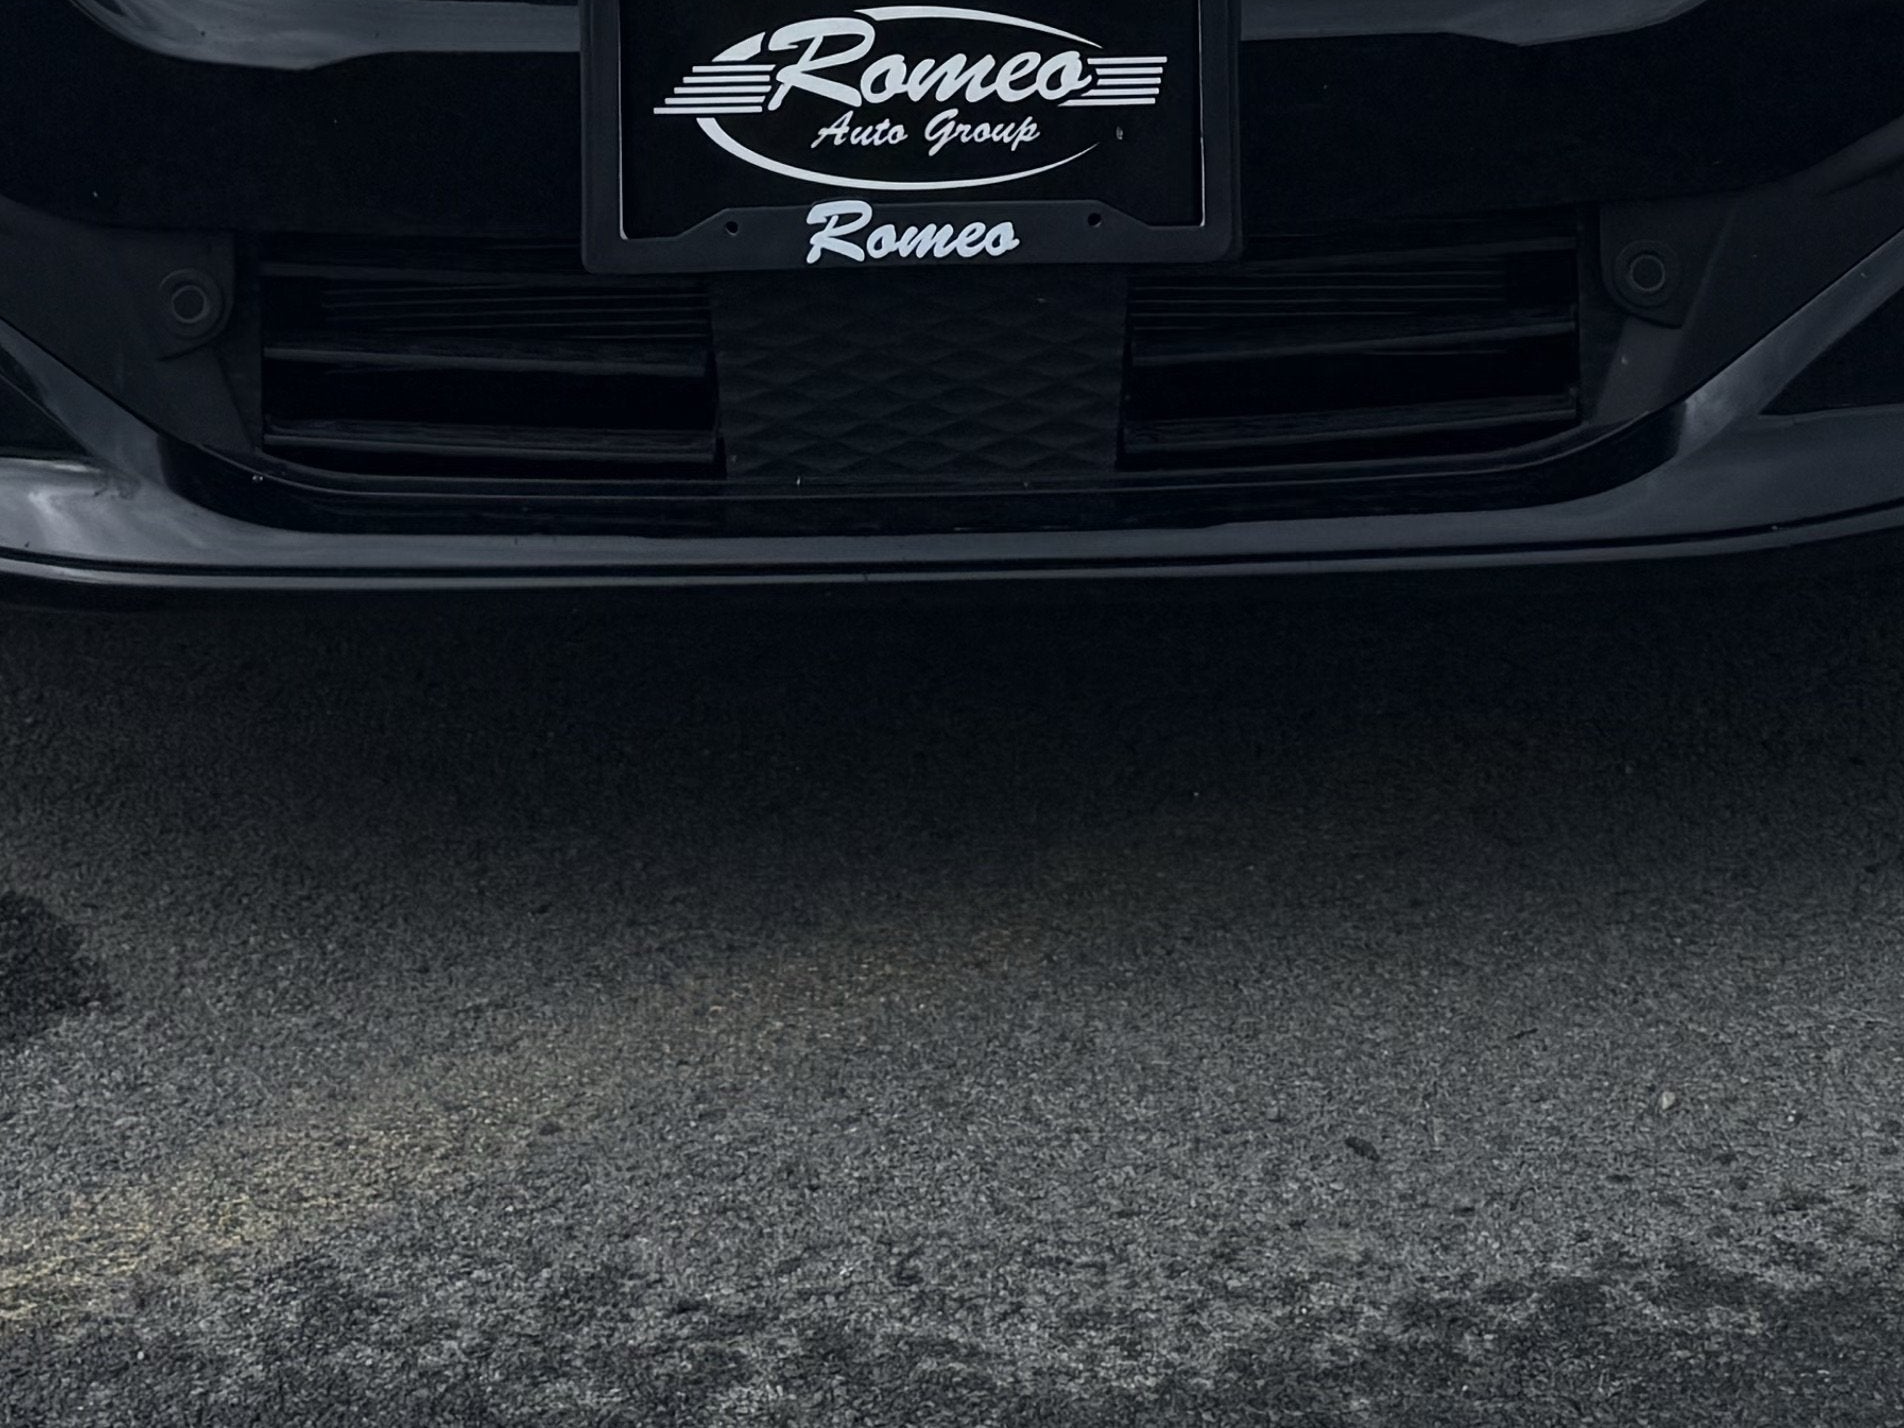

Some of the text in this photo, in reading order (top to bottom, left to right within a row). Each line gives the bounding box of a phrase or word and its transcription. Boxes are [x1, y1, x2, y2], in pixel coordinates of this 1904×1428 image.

[767, 17, 1093, 111] Romeo
[810, 108, 1041, 157] Auto Group
[806, 199, 1020, 264] Romeo
